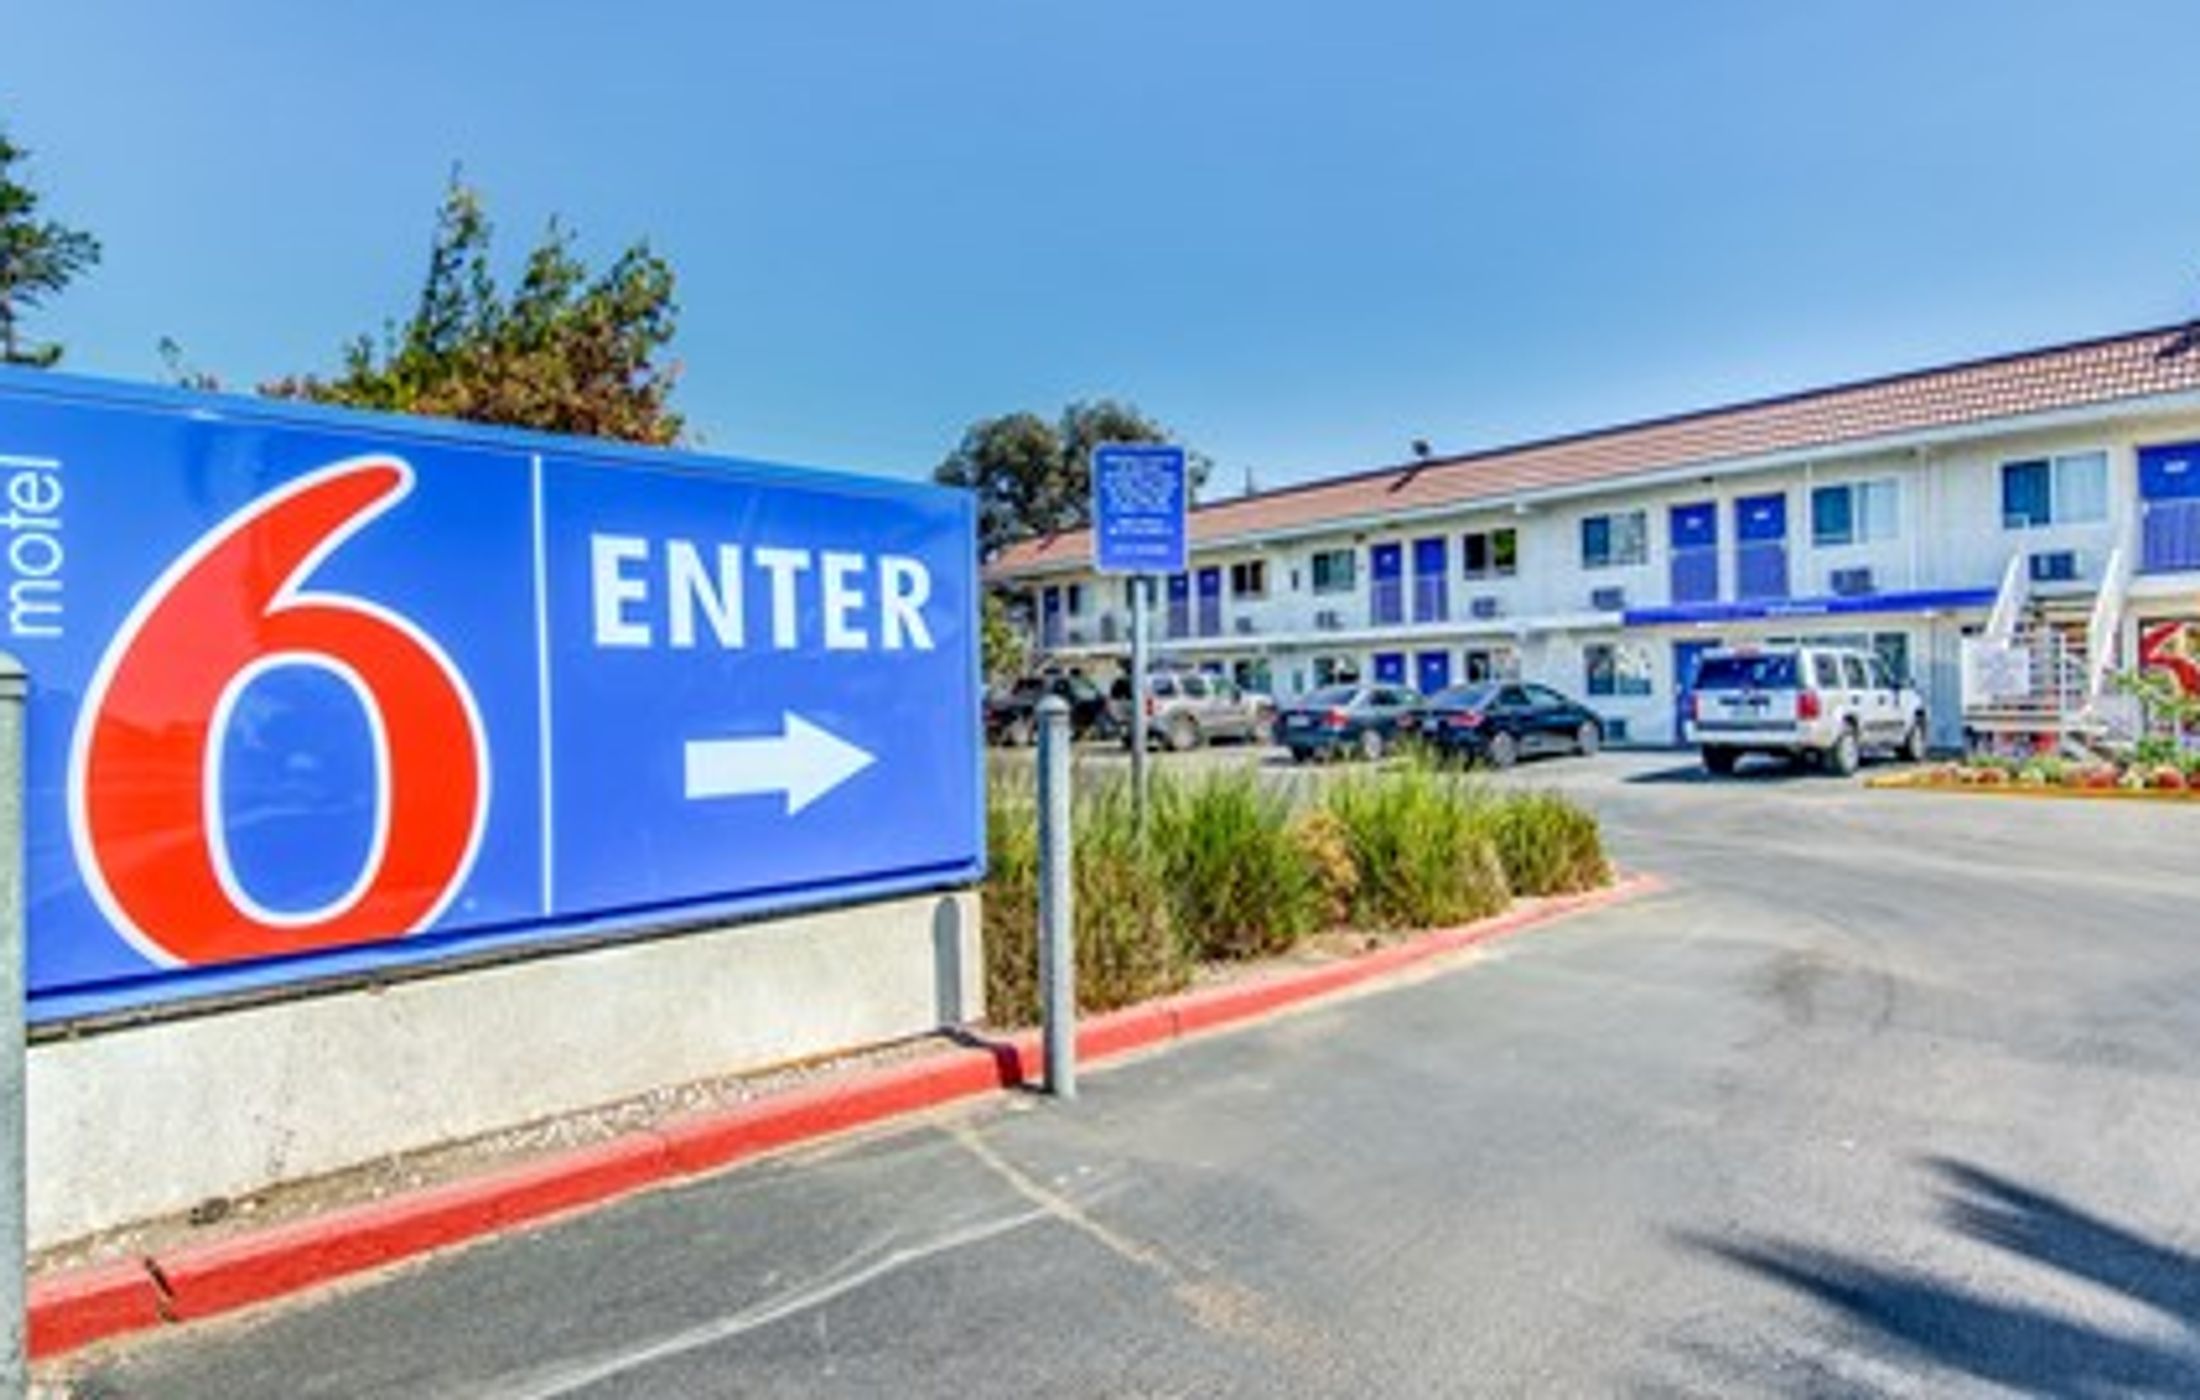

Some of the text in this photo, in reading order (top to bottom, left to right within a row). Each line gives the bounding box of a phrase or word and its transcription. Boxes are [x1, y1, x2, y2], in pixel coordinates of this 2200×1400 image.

[0, 455, 63, 635] motel
[590, 533, 935, 650] ENTER
[68, 454, 490, 969] 6
